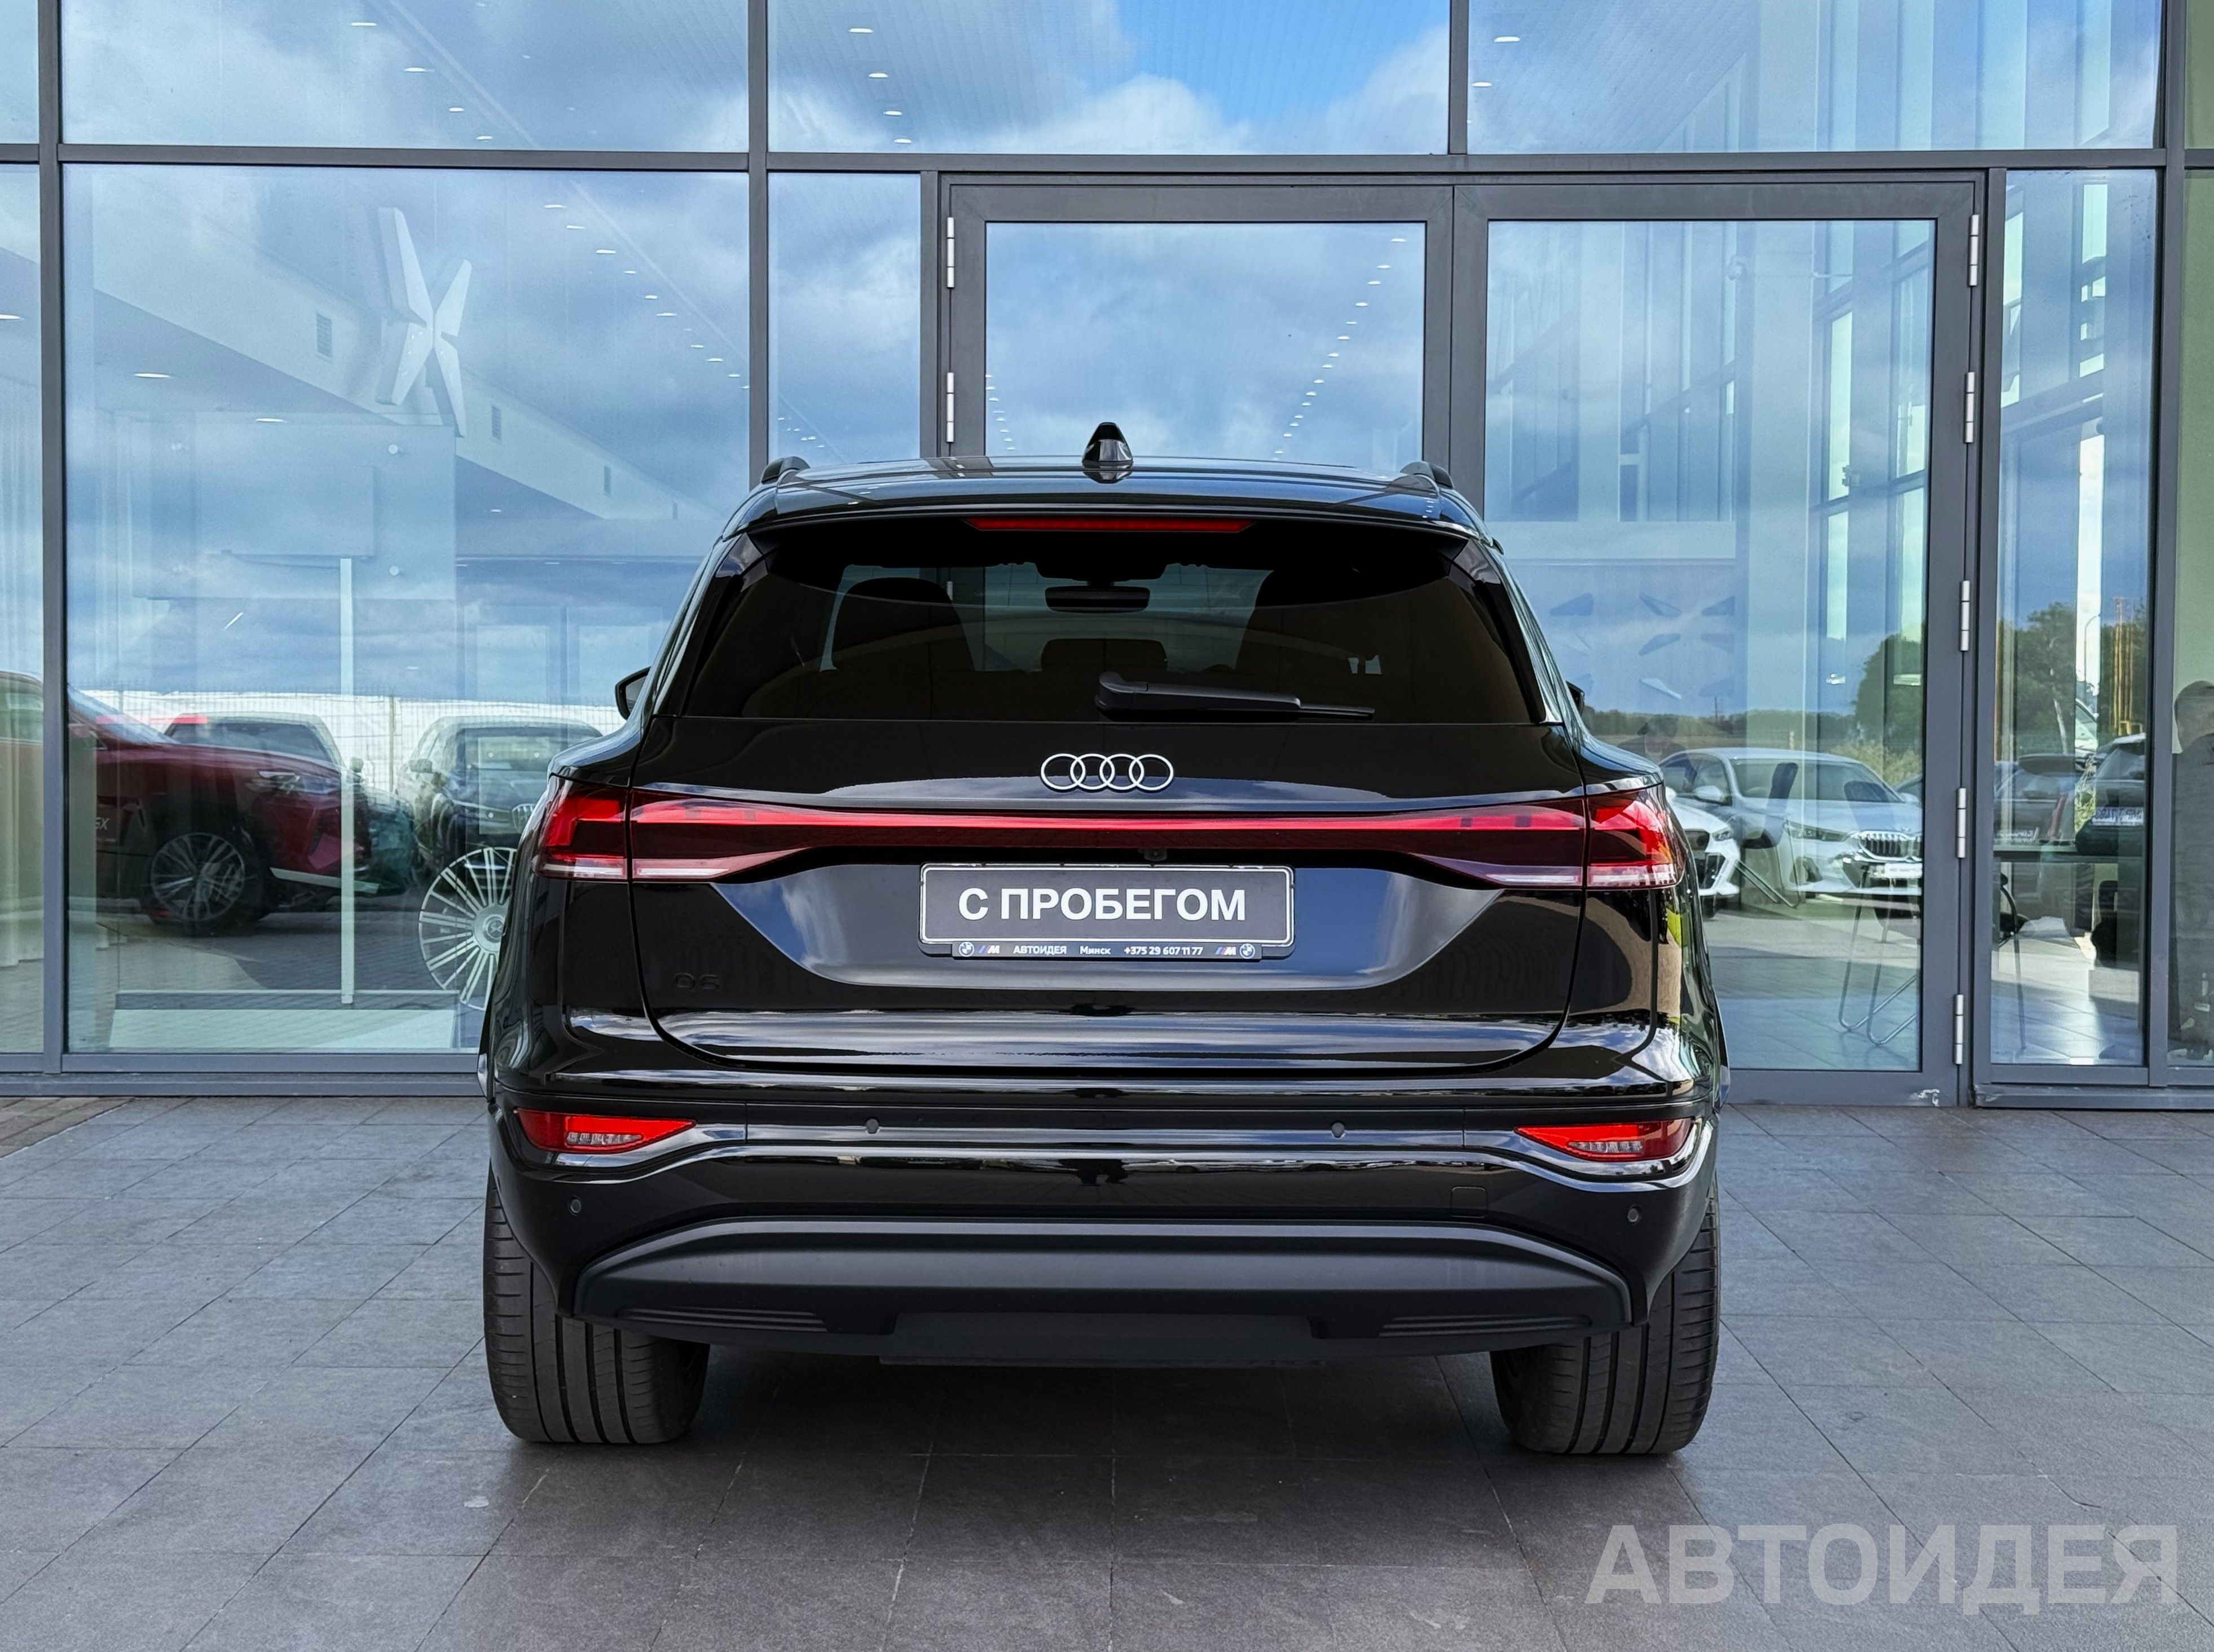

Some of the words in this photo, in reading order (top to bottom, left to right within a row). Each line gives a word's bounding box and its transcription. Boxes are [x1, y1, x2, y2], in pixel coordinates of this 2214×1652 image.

[958, 888, 989, 920] С
[1001, 888, 1245, 921] ПРОБЕГОМ
[1013, 945, 1067, 955] АВТОИДЕЯ
[1080, 945, 1111, 955] Минск
[1124, 946, 1147, 955] +375
[1148, 946, 1161, 955] 29
[1163, 946, 1181, 955] 607
[1181, 946, 1190, 955] 11
[1191, 946, 1204, 955] 77
[672, 972, 720, 992] Q6
